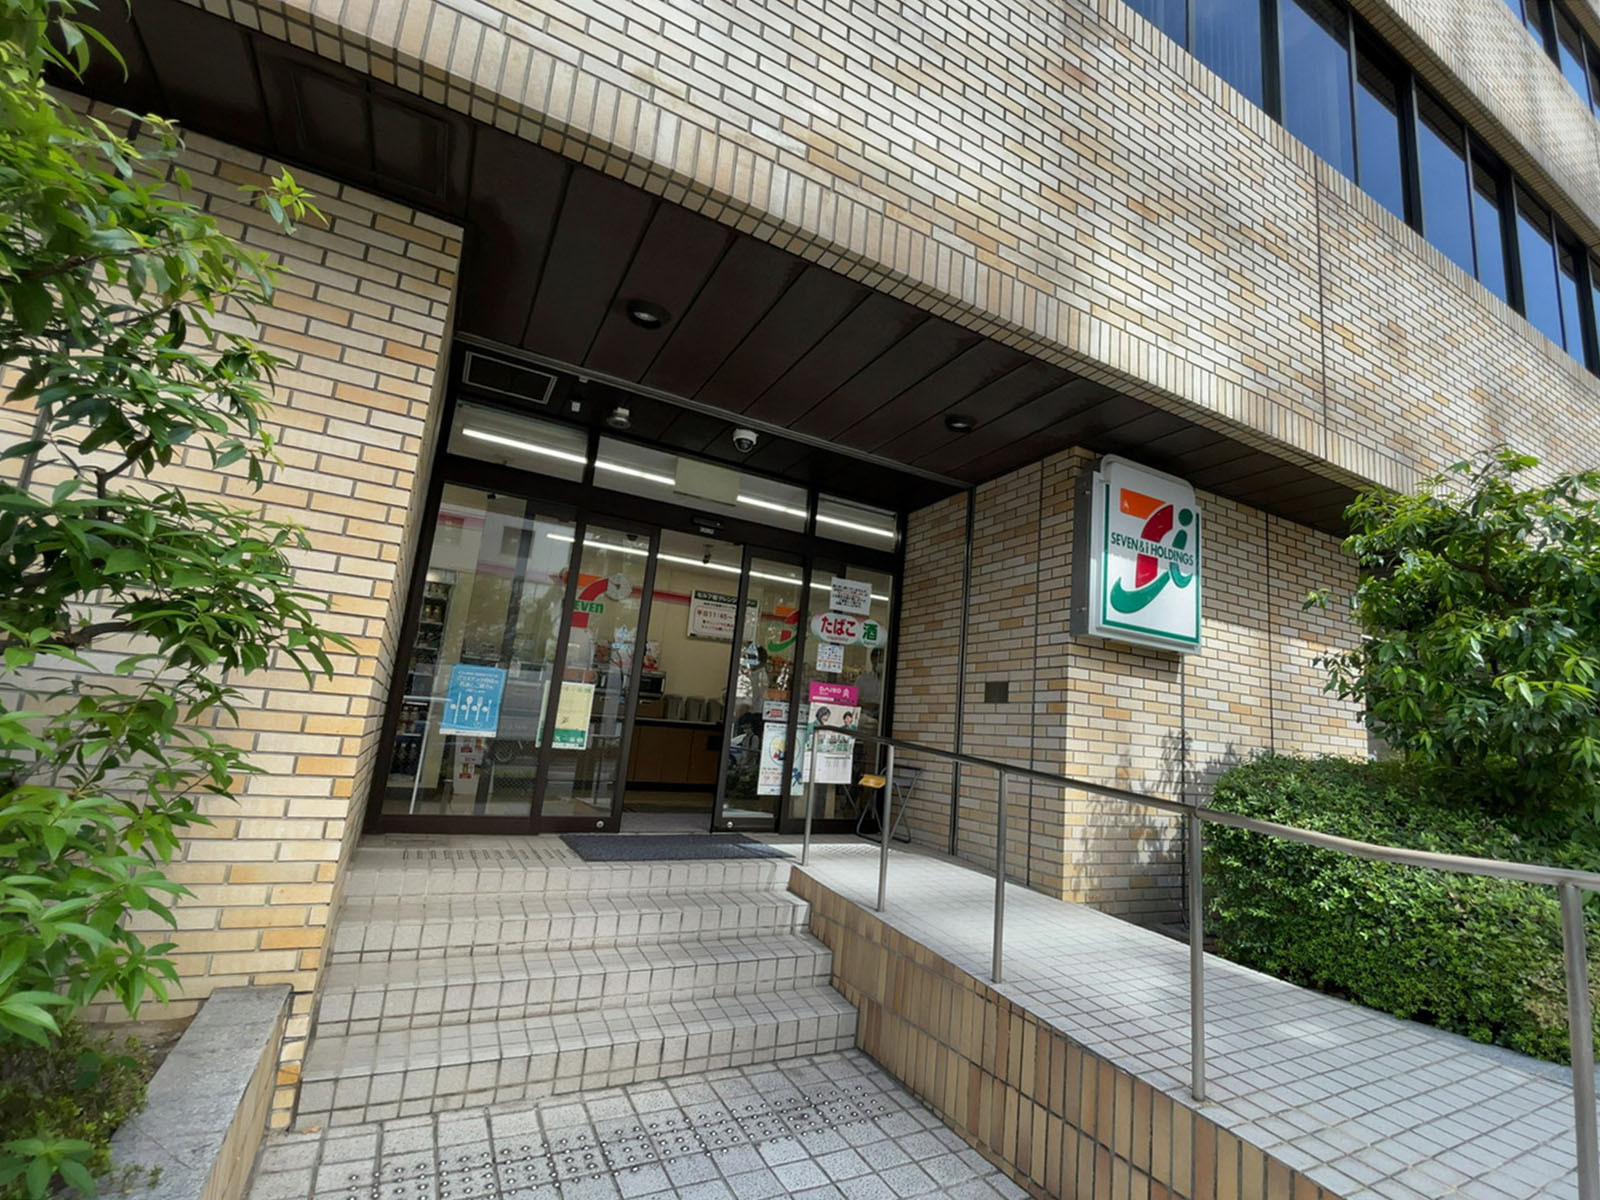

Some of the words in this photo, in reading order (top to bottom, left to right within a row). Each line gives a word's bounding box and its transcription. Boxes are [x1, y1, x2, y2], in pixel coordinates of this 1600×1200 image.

[1150, 544, 1193, 566] HOLDINGS
[821, 616, 856, 637] たばこ
[862, 622, 878, 641] 酒
